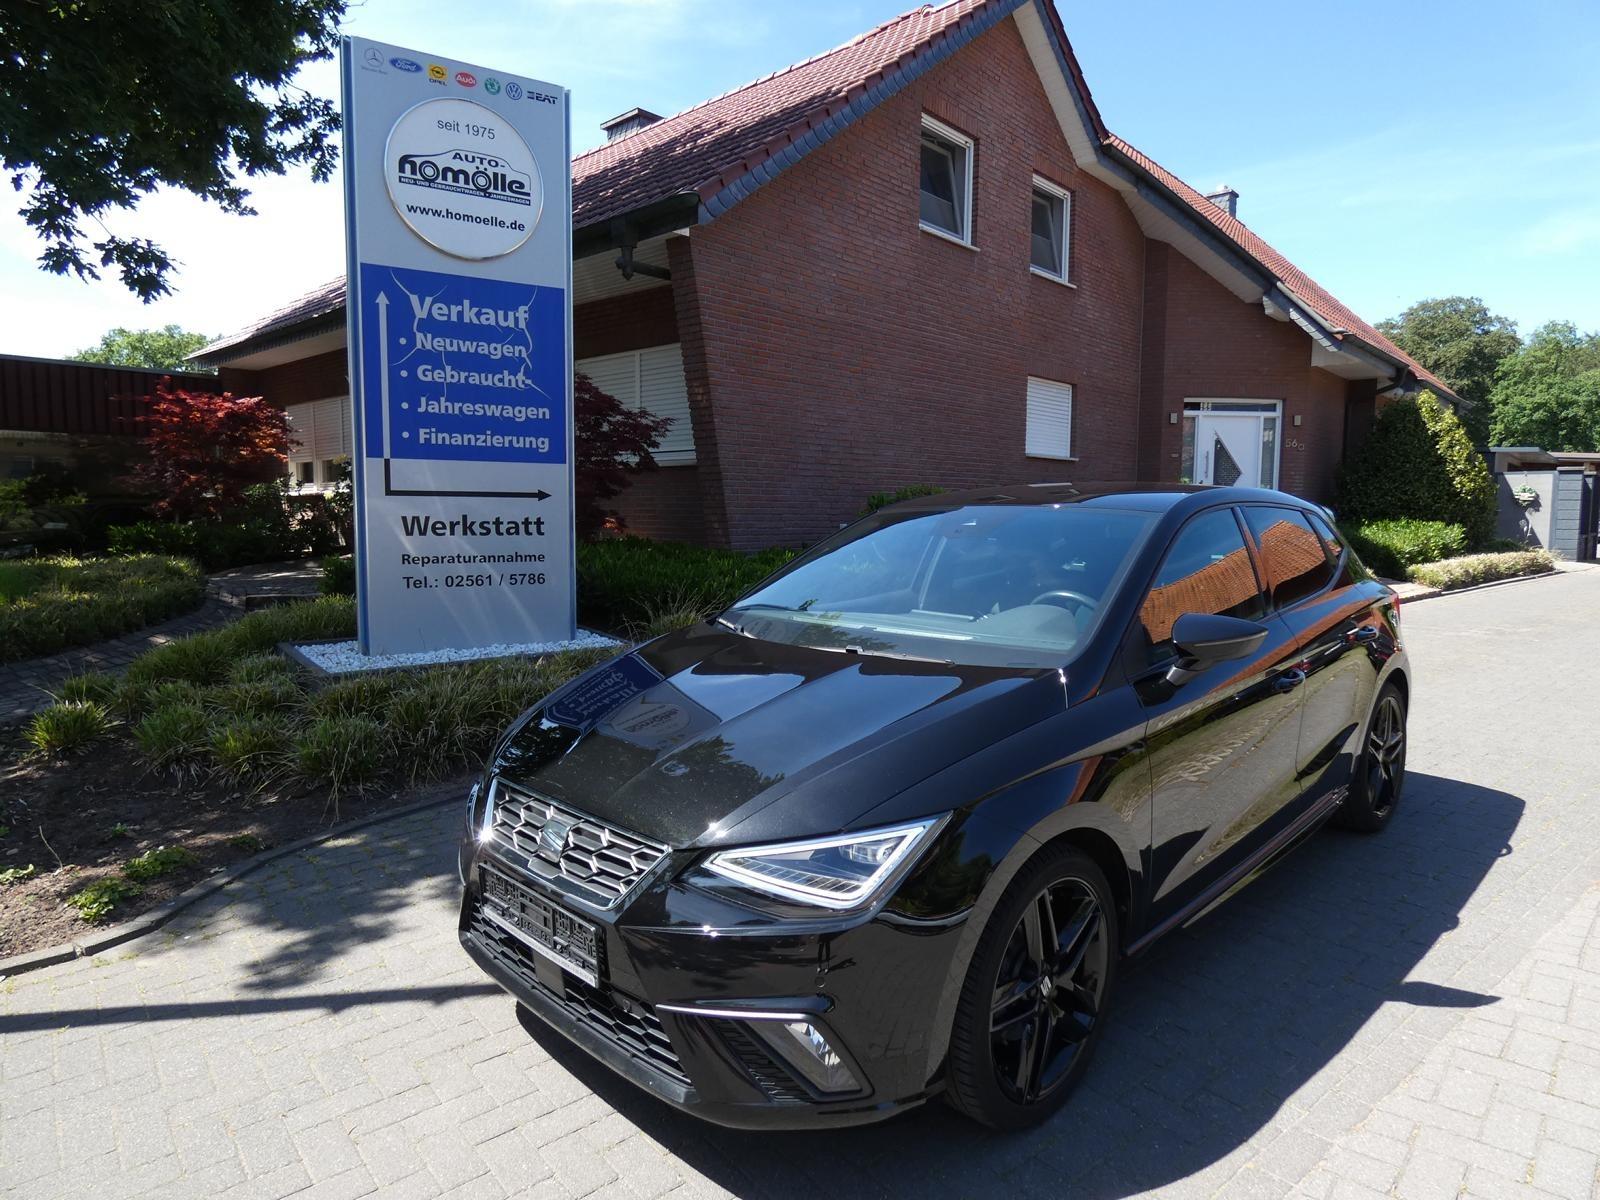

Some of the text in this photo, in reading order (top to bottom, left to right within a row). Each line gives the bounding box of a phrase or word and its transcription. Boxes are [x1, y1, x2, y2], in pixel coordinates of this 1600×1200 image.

[395, 60, 418, 72] Ford
[428, 78, 447, 87] OPEL
[527, 91, 558, 105] SEAT
[437, 118, 496, 140] seit 1975
[452, 152, 505, 168] AUTO-
[430, 182, 485, 197] GEBRAUCHTWAGEN
[406, 203, 526, 232] www.homoelle.de
[409, 294, 529, 329] Verkauf
[416, 332, 527, 359] Neuwagen
[416, 364, 532, 388] Gebraucht-
[417, 396, 550, 422] Jahreswagen
[418, 427, 550, 453] Finanzierung
[401, 514, 545, 537] Werkstatt
[401, 552, 546, 567] Reparaturannahme
[402, 575, 439, 589] Tel.:
[445, 574, 493, 588] 02561
[509, 572, 546, 586] 5786
